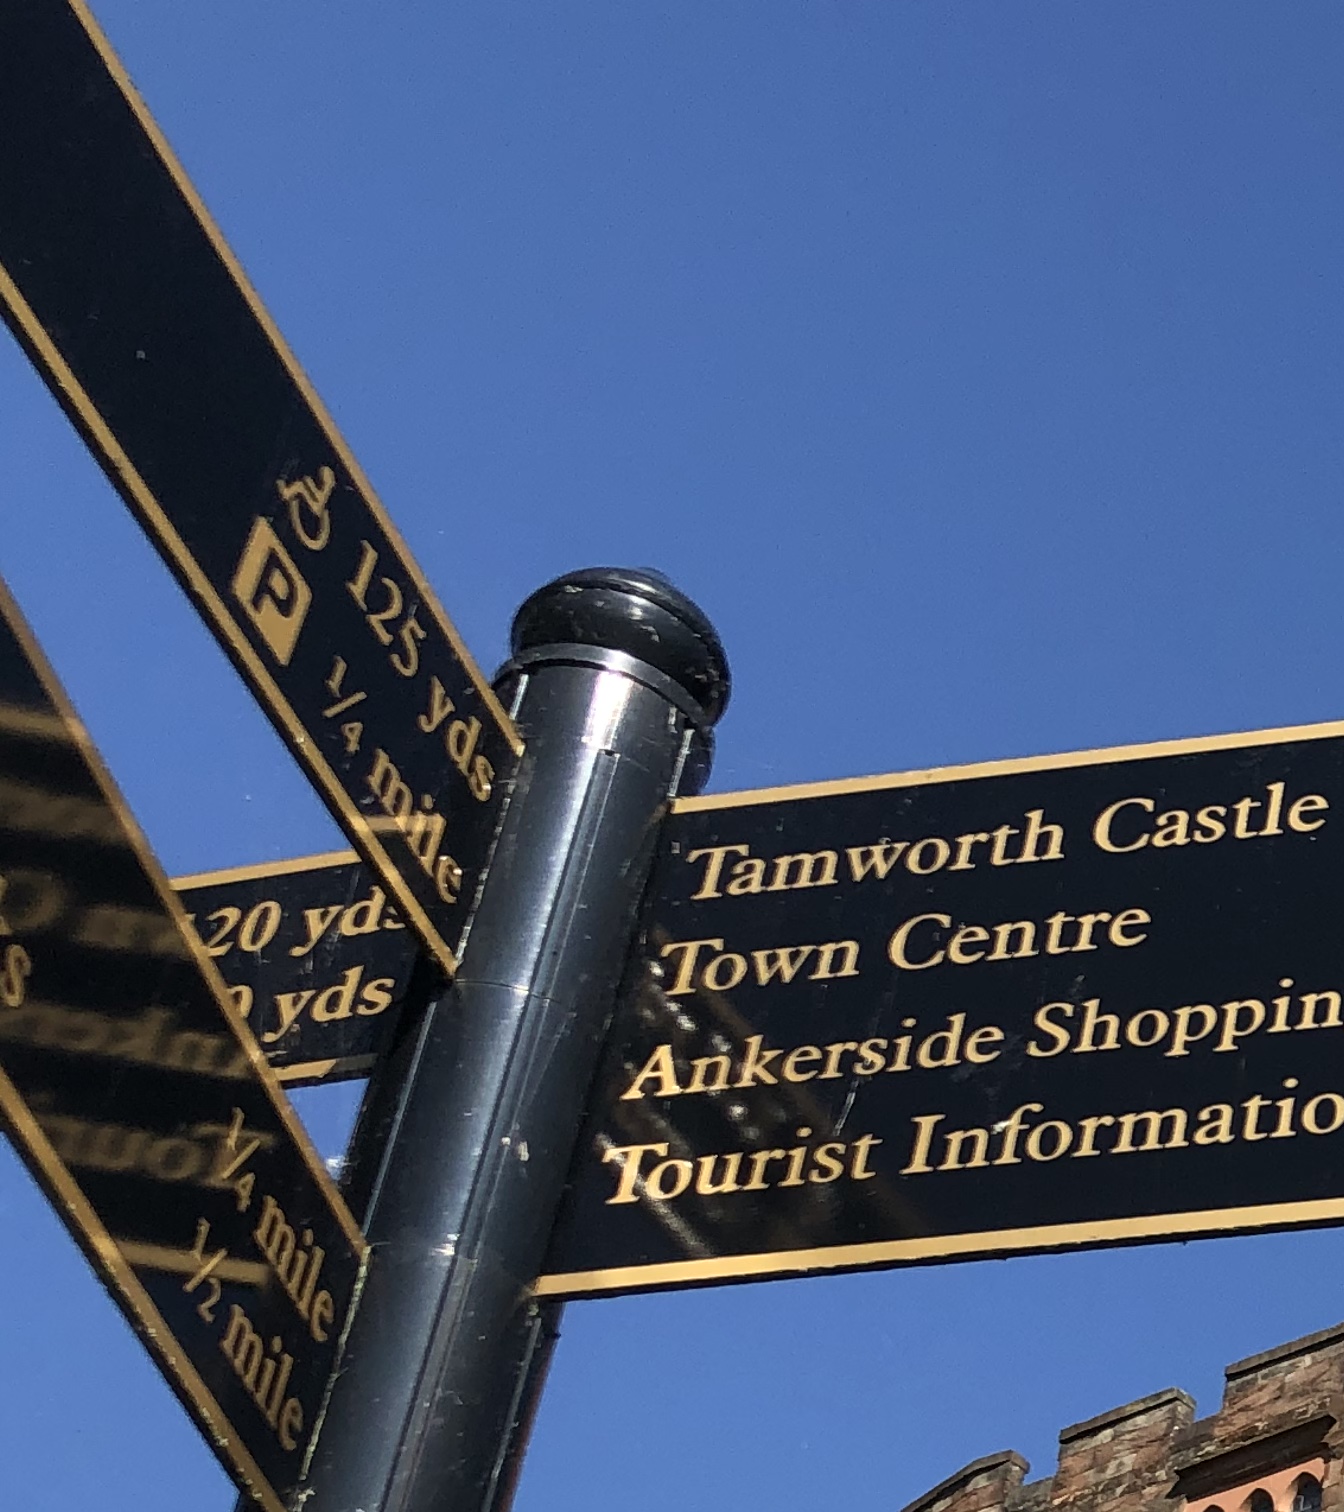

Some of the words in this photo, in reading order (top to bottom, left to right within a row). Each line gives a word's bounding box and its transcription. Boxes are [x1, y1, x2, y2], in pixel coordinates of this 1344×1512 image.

[346, 540, 427, 677] 125
[417, 675, 494, 801] yds
[367, 749, 462, 903] mile
[688, 809, 1064, 900] Tamworth
[1093, 781, 1329, 853] Castle
[186, 900, 282, 957] 20
[660, 938, 859, 996] Town
[889, 908, 1151, 970] Centre
[262, 965, 396, 1043] yds
[620, 1013, 1004, 1100] Ankerside
[602, 1127, 882, 1204] Tourist
[254, 1195, 334, 1342] mile
[220, 1303, 303, 1450] mile
